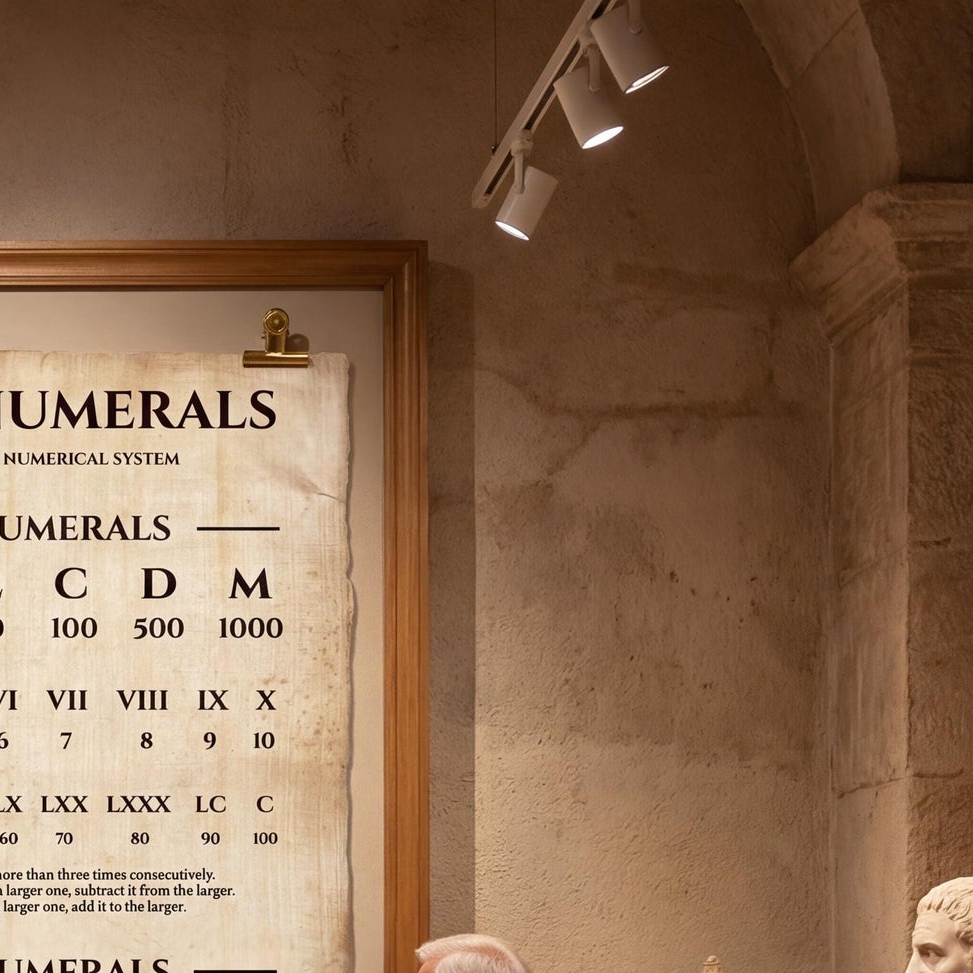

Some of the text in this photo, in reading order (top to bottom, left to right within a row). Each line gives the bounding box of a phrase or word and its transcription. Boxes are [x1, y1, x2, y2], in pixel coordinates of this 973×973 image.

[3, 452, 109, 466] NUMERICAL
[112, 452, 180, 466] SYSTEM
[54, 567, 88, 600] C
[141, 567, 177, 600] D
[228, 567, 273, 599] M
[51, 617, 98, 639] 100
[133, 617, 185, 640] 500
[219, 617, 284, 639] 1000
[46, 689, 88, 711] VII
[116, 689, 168, 711] VIII
[197, 689, 230, 711] IX
[255, 689, 277, 711] X
[60, 732, 73, 750] 7
[140, 731, 154, 750] 8
[203, 731, 217, 750] 9
[253, 731, 275, 750] 10
[40, 795, 89, 813] LXX
[106, 795, 172, 813] LXXX
[195, 795, 227, 814] LC
[256, 795, 274, 813] C
[0, 831, 19, 845] 60
[55, 832, 74, 845] 70
[130, 831, 150, 845] 80
[200, 831, 221, 845] 90
[253, 831, 279, 845] 100
[26, 867, 55, 881] than
[57, 867, 90, 881] three
[92, 868, 127, 881] times
[129, 867, 216, 884] consecutively.
[6, 883, 44, 900] larger
[45, 887, 72, 899] one,
[74, 883, 126, 897] subtract
[127, 883, 137, 897] it
[139, 883, 171, 897] from
[173, 883, 194, 897] the
[196, 883, 236, 900] larger.
[3, 899, 41, 916] larger
[42, 903, 69, 915] one,
[71, 899, 95, 913] add
[98, 900, 107, 913] it
[109, 901, 123, 913] to
[124, 899, 145, 913] the
[147, 899, 187, 916] larger.
